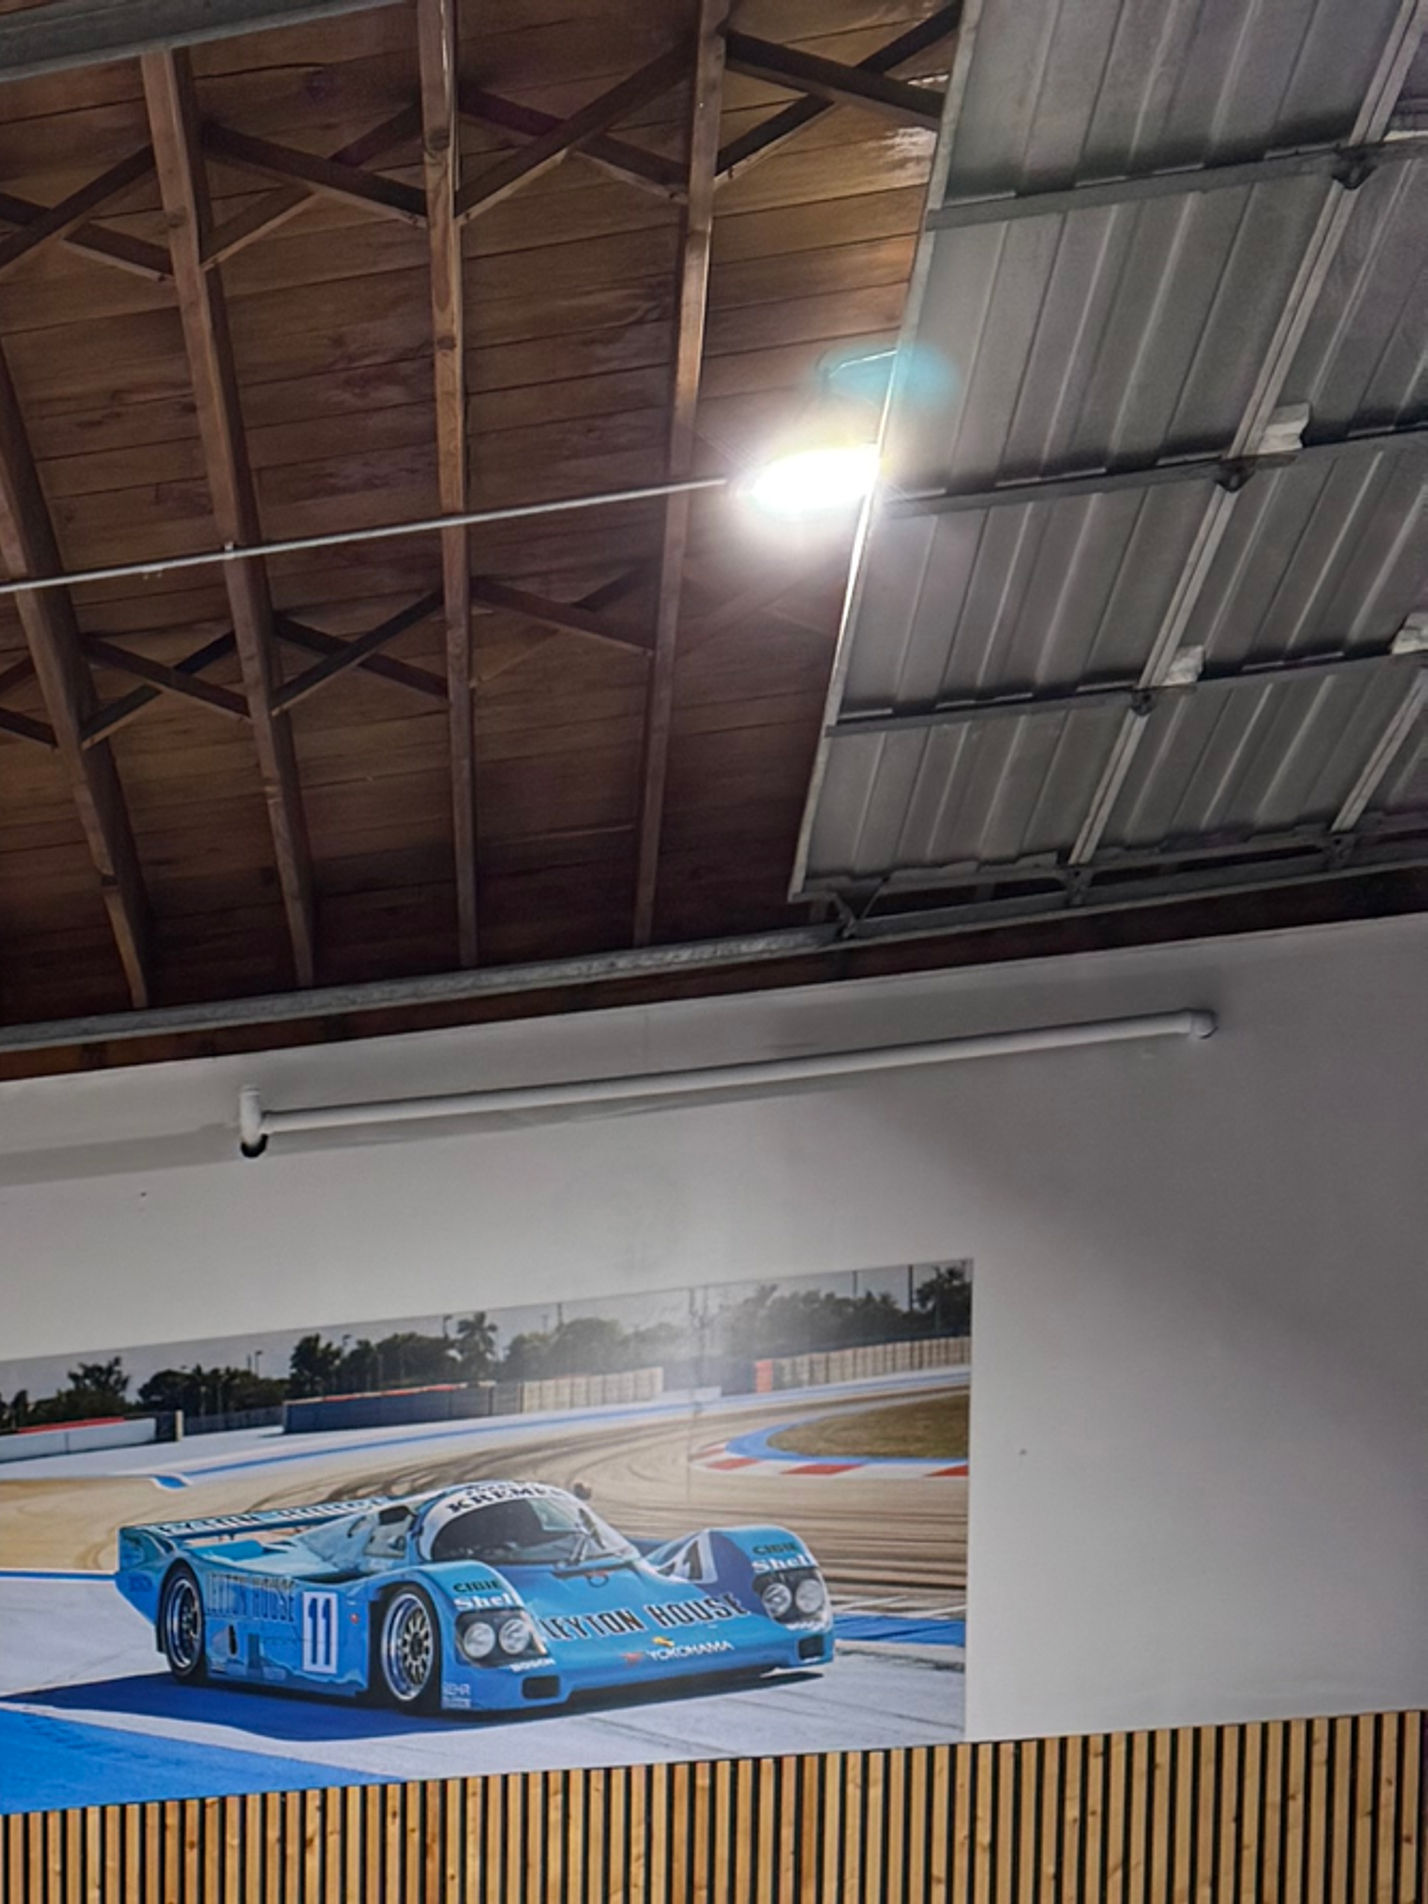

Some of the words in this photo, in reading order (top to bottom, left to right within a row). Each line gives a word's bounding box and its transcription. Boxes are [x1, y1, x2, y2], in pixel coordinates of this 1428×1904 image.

[307, 1598, 332, 1666] 11
[540, 1608, 648, 1641] LEYTON
[644, 1592, 752, 1629] HOUSE
[647, 1640, 735, 1661] YOKOHAMA
